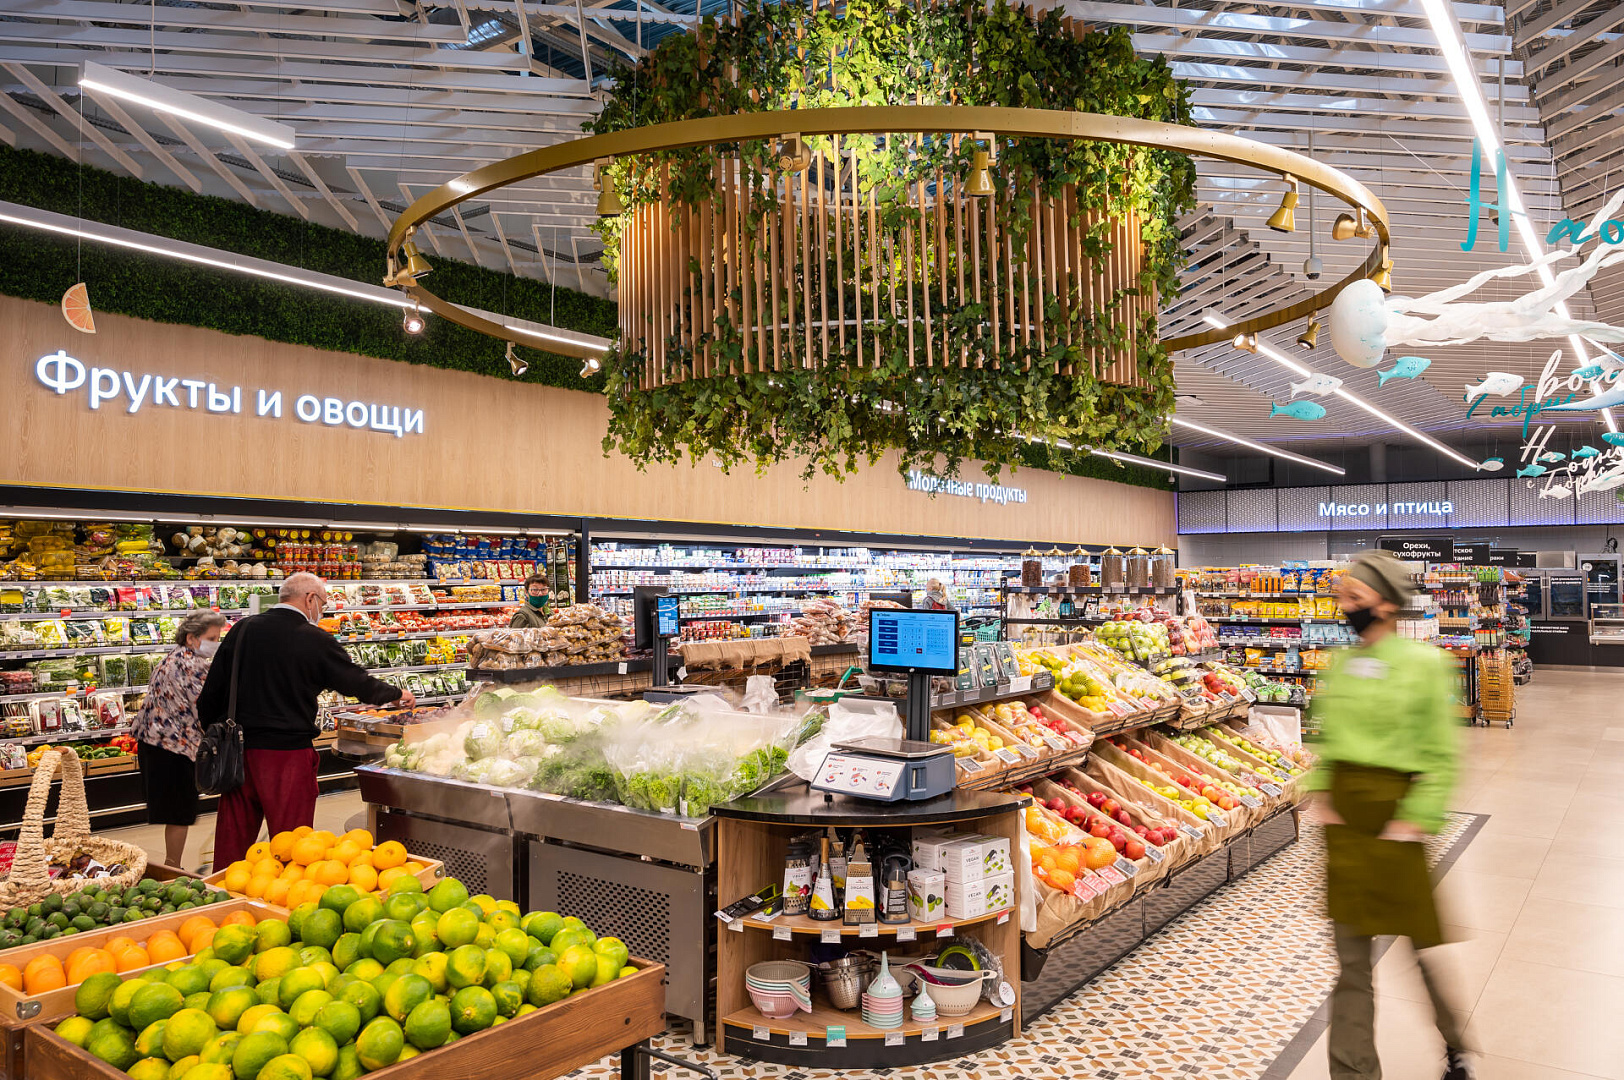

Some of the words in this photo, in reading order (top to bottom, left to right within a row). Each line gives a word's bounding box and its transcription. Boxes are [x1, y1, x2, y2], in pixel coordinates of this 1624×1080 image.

[35, 350, 242, 414] Фрукты
[257, 389, 283, 418] и
[295, 394, 425, 438] овощи
[975, 483, 1028, 505] продукты
[1319, 502, 1370, 517] Мясо
[1376, 503, 1387, 515] и
[1393, 500, 1454, 516] птица
[1393, 549, 1442, 558] сухофрукты
[1403, 542, 1431, 550] Орехи,
